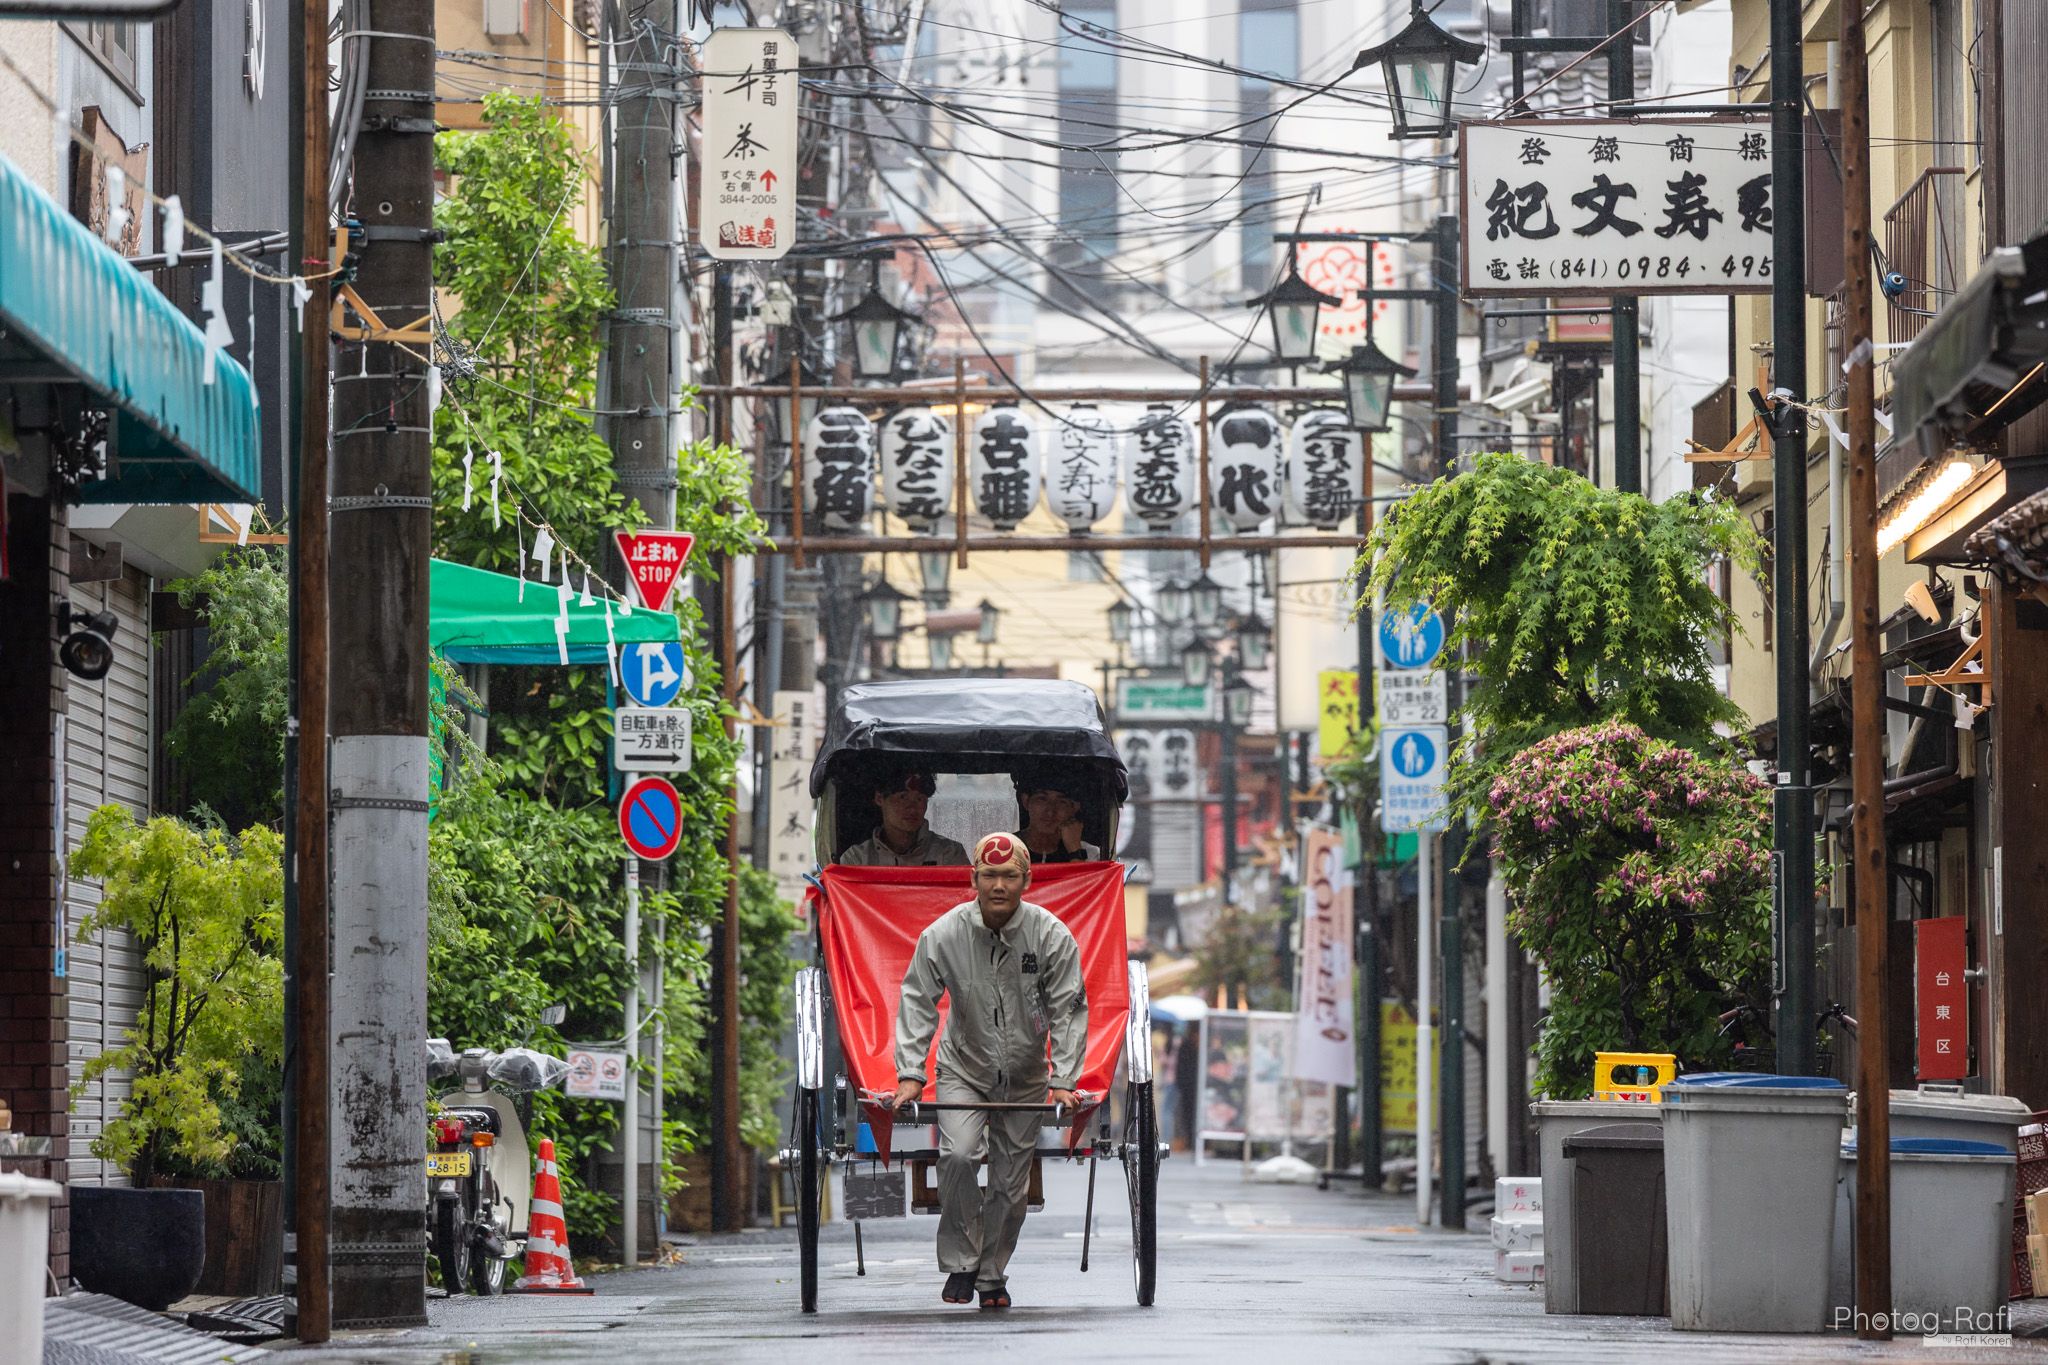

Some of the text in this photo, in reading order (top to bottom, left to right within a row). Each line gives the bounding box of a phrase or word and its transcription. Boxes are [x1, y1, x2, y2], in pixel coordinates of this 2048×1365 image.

[762, 41, 778, 106] 御菓子司
[720, 170, 757, 181] すぐ先
[725, 182, 752, 193] 右側
[720, 194, 777, 204] 3844-2005
[1219, 417, 1271, 515] 一代
[631, 541, 678, 562] 止まれ
[639, 566, 672, 582] STOP
[621, 715, 685, 731] 自転車を除く
[621, 734, 685, 749] 一方通行
[1936, 971, 1950, 1053] 台東区
